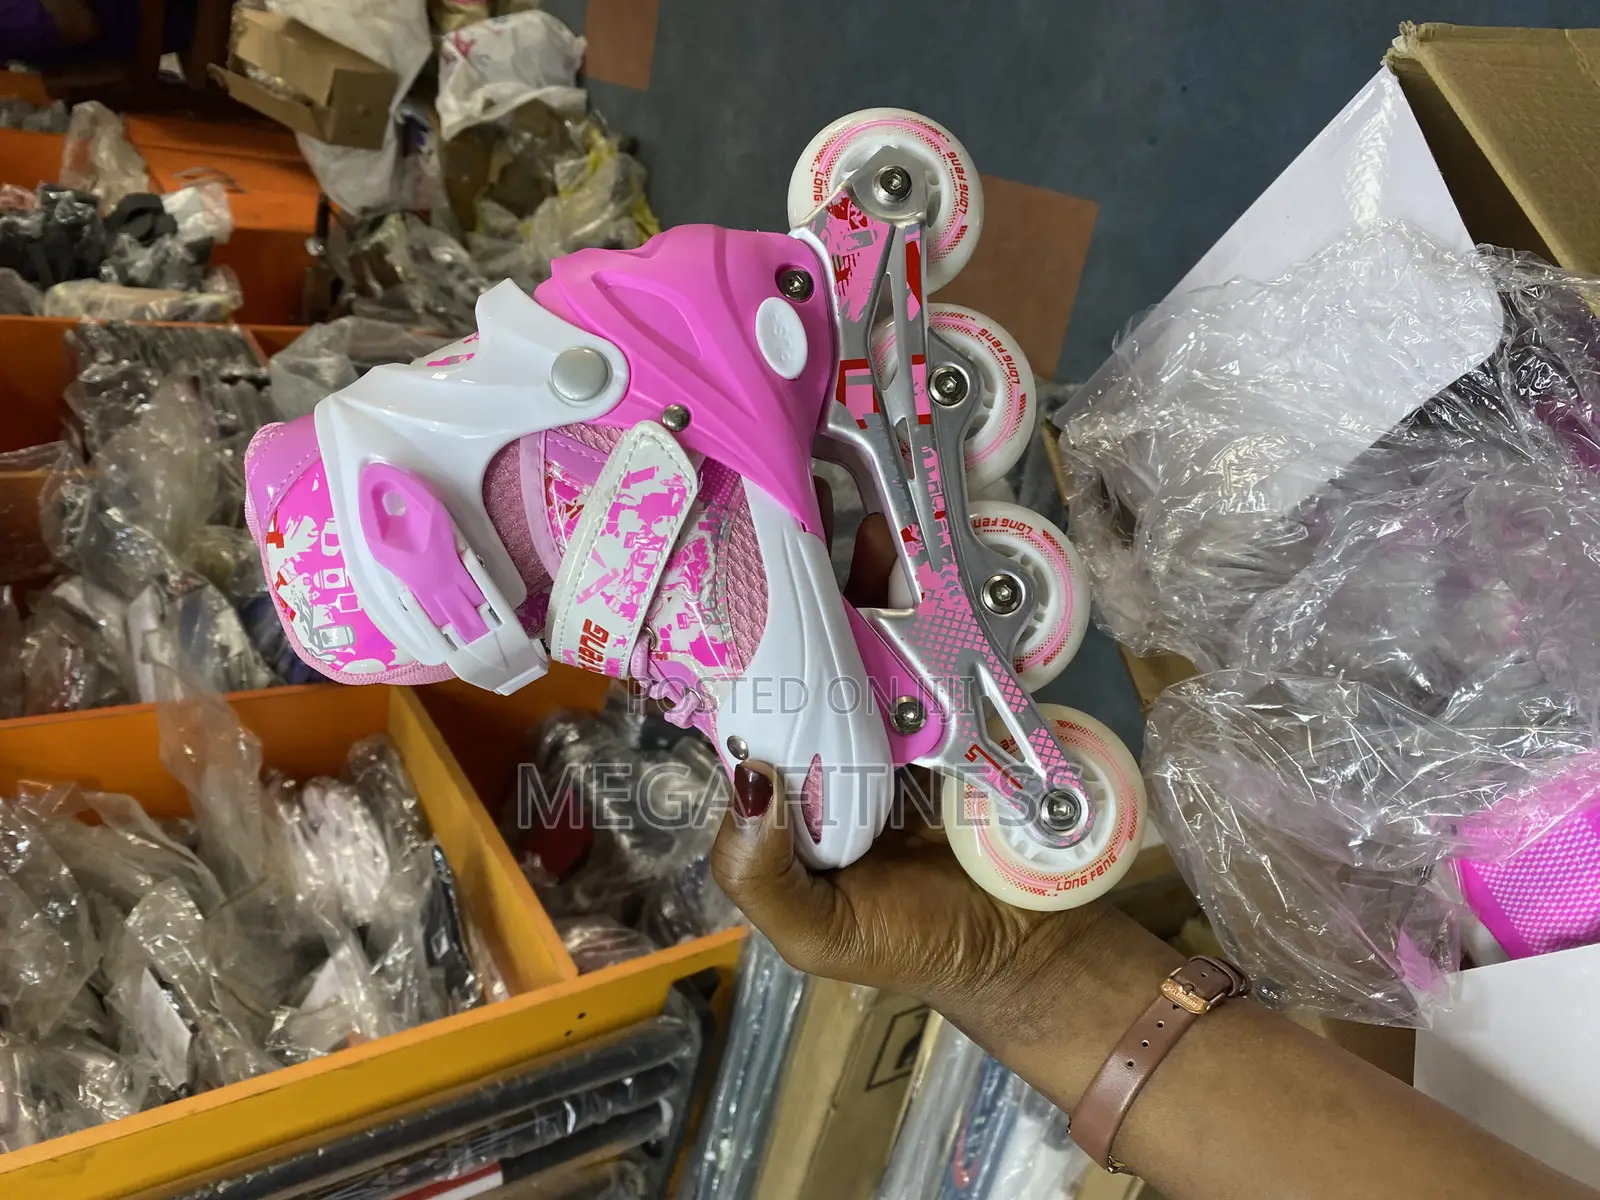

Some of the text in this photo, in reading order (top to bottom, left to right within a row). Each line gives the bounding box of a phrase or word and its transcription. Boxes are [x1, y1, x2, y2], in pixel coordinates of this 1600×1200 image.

[813, 171, 825, 202] LONG
[958, 183, 969, 215] LONG
[1002, 355, 1021, 385] LONG
[1000, 518, 1034, 535] LONG
[1056, 875, 1088, 892] LONG
